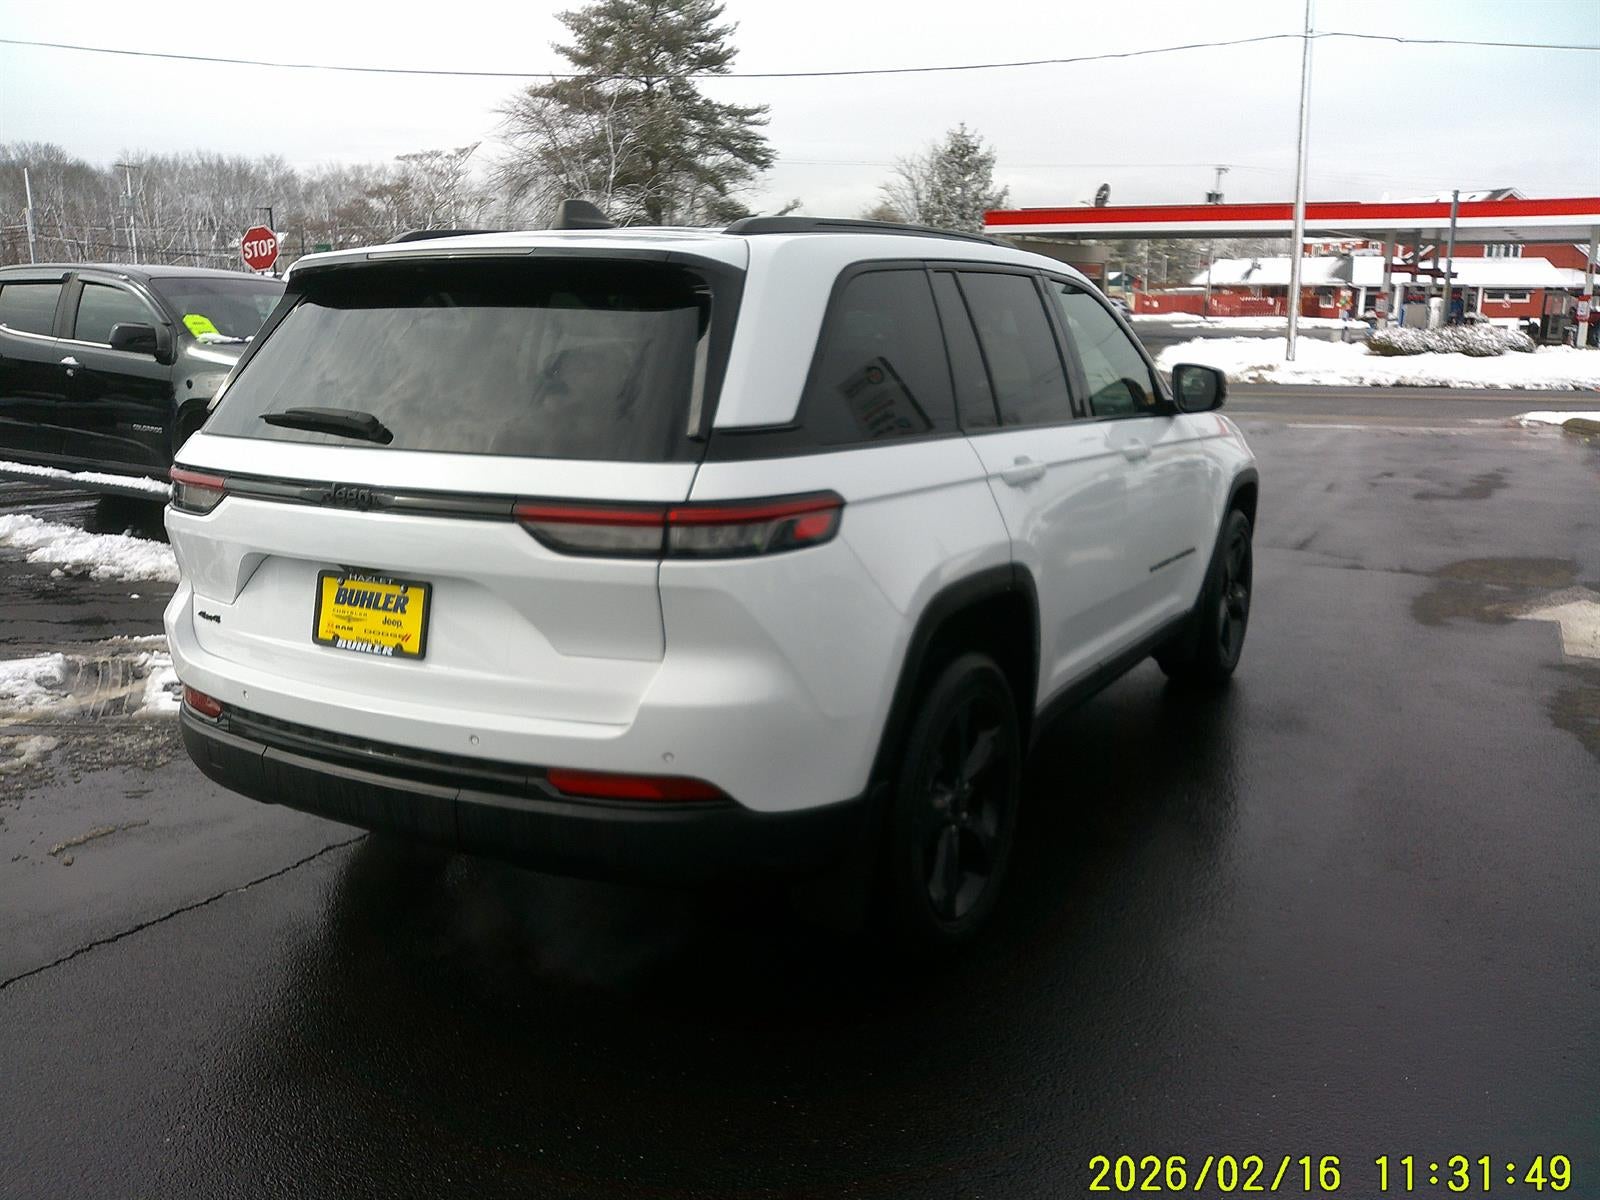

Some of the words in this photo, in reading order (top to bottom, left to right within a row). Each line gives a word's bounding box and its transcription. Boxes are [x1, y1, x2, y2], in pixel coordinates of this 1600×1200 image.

[243, 238, 276, 260] STOP
[132, 423, 162, 434] COLORADO
[335, 587, 409, 614] BUHLER
[382, 616, 403, 628] Jeep
[336, 639, 394, 656] BUHLER
